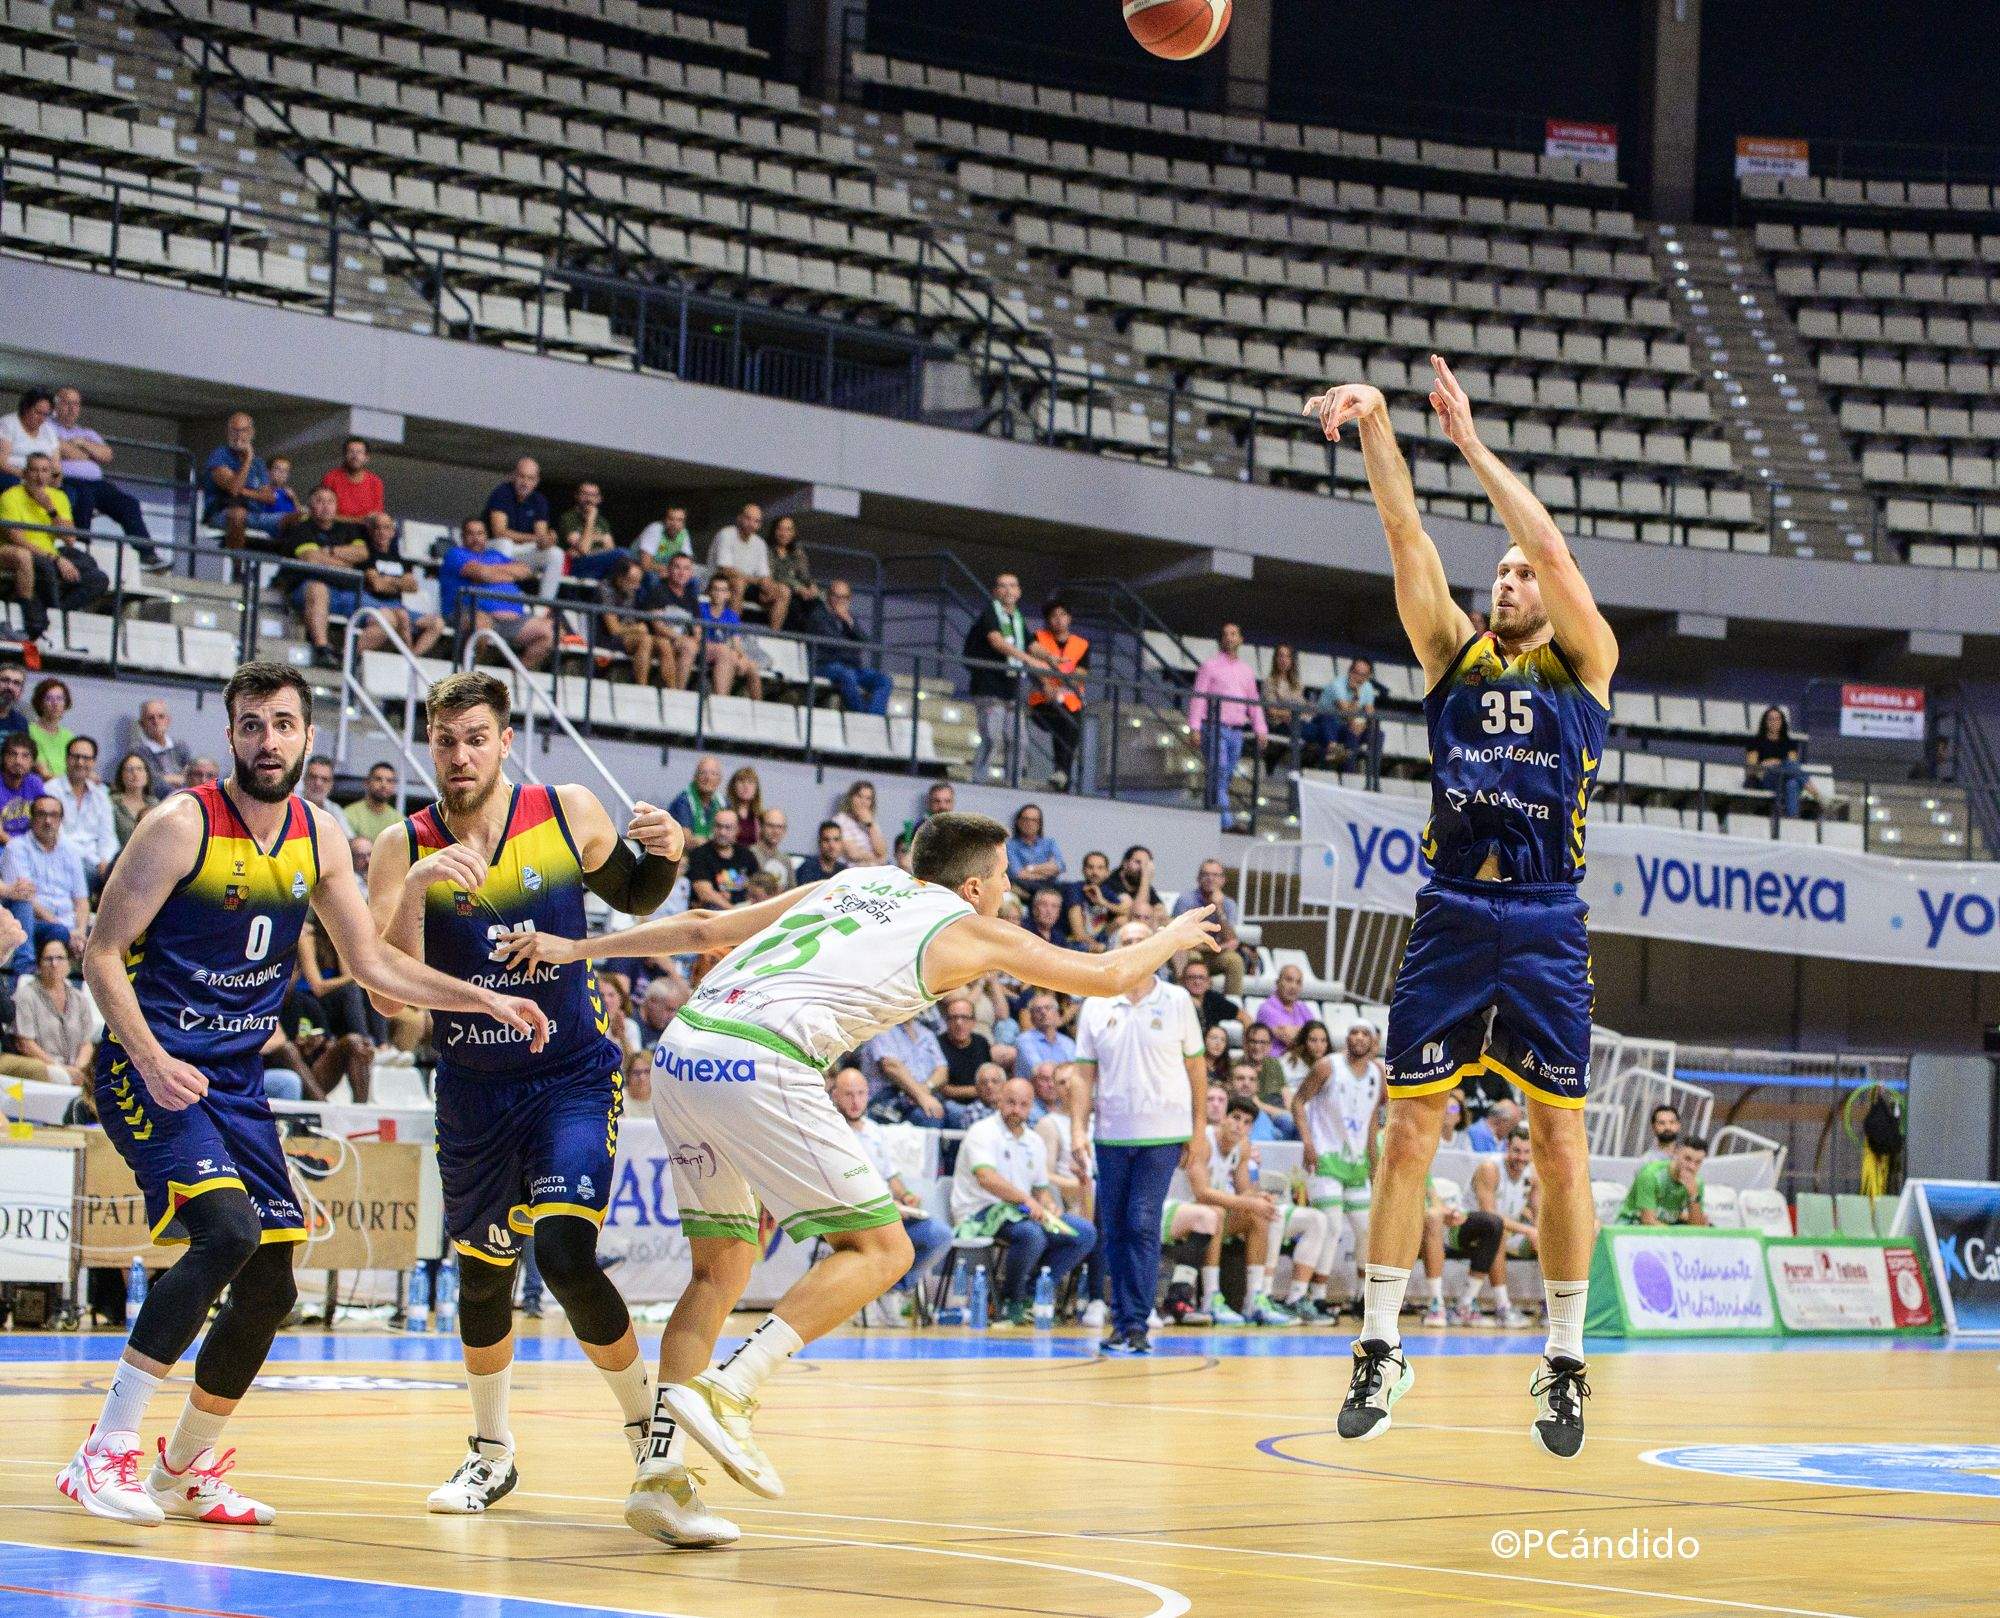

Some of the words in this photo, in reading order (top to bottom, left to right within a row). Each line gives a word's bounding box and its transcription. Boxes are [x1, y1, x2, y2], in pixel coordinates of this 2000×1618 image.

[1481, 690, 1534, 735] 35
[1465, 744, 1560, 769] MORABANC
[1636, 854, 1847, 924] younexa
[1918, 888, 2000, 950] yo
[245, 914, 272, 961] 0
[208, 962, 282, 988] MORABANC
[466, 964, 560, 990] ORABANC
[207, 1012, 280, 1034] Andorr
[466, 1018, 558, 1046] Andora
[653, 1045, 757, 1082] ounexa
